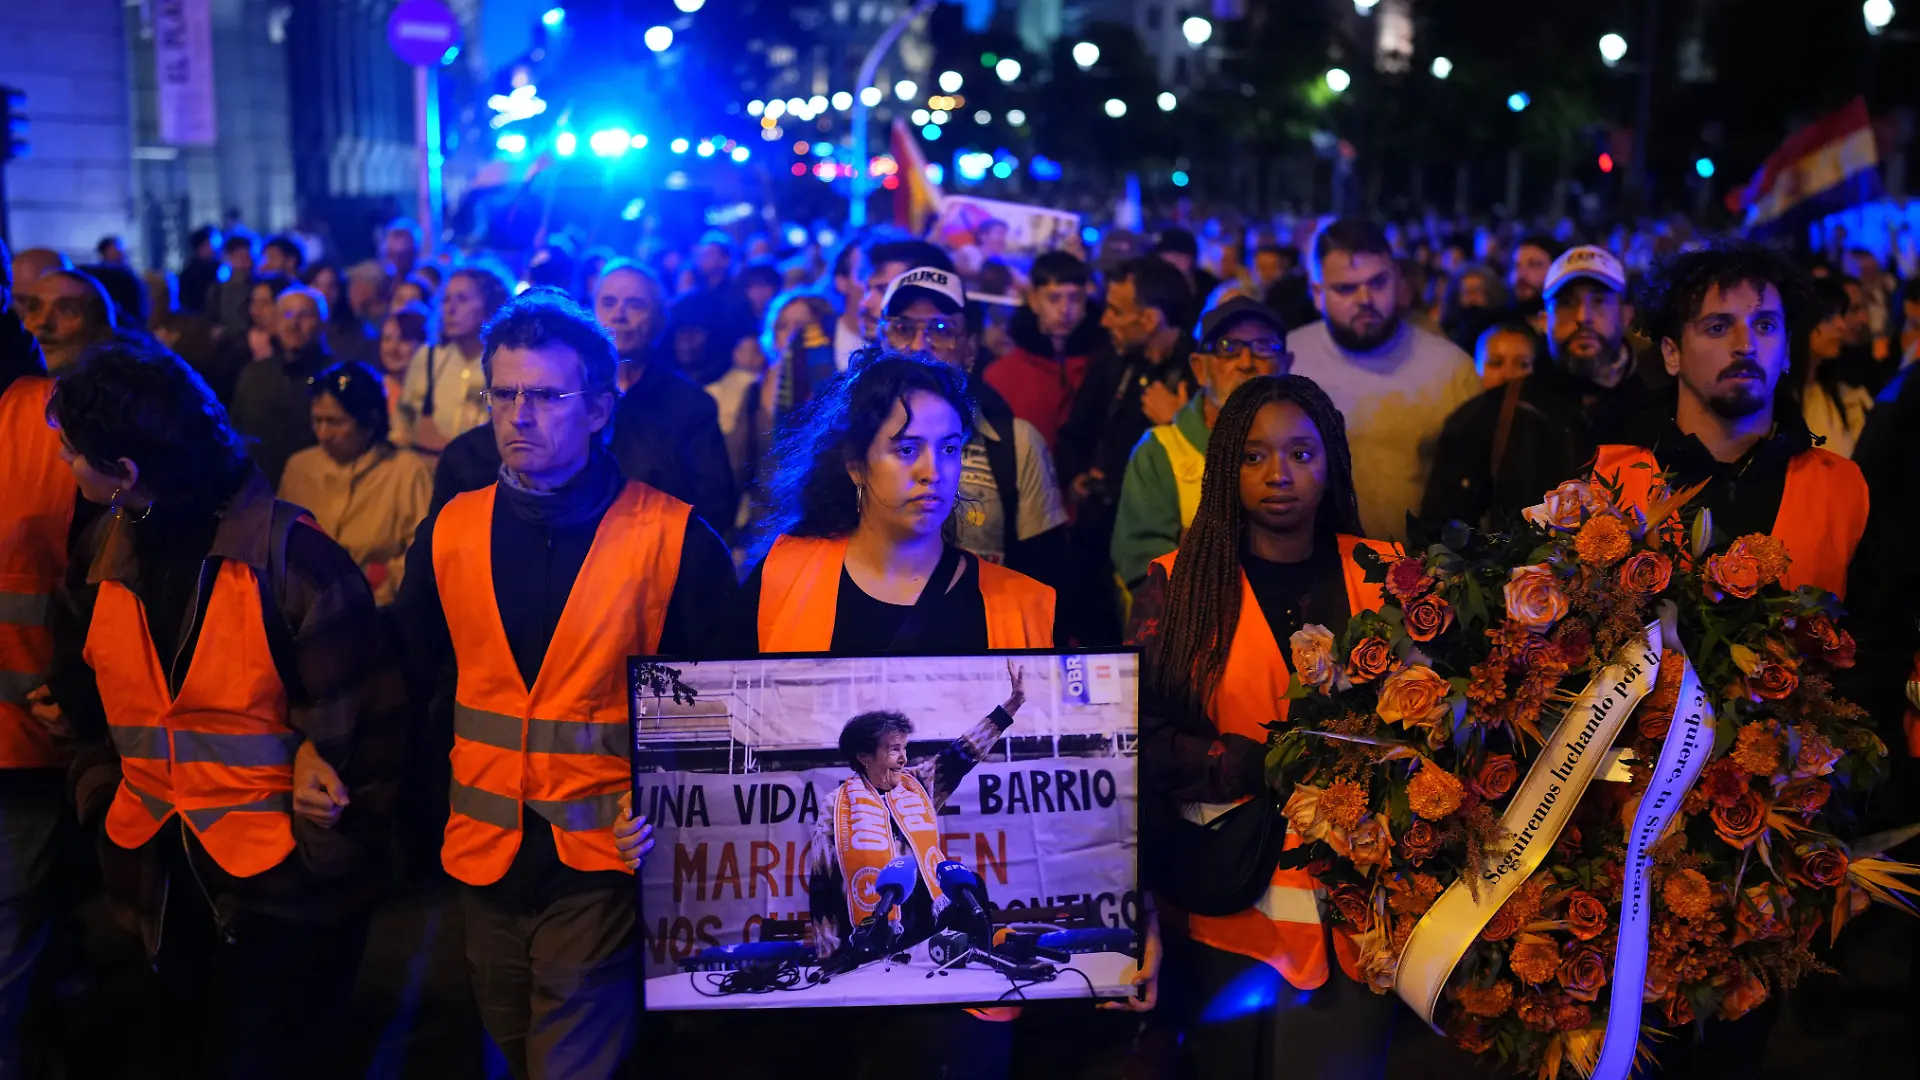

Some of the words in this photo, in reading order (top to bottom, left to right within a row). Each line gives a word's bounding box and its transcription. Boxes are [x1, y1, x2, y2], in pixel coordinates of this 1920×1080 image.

[1483, 783, 1561, 885] Seguiremos
[1550, 695, 1614, 783] luchando
[1613, 663, 1643, 699] por
[1643, 648, 1661, 666] ti
[1665, 711, 1702, 784] quiere,
[639, 784, 711, 829] UNA
[733, 781, 820, 826] VIDA
[978, 769, 1116, 815] BARRIO
[1652, 787, 1673, 809] tu
[1630, 815, 1660, 922] Sindicato.
